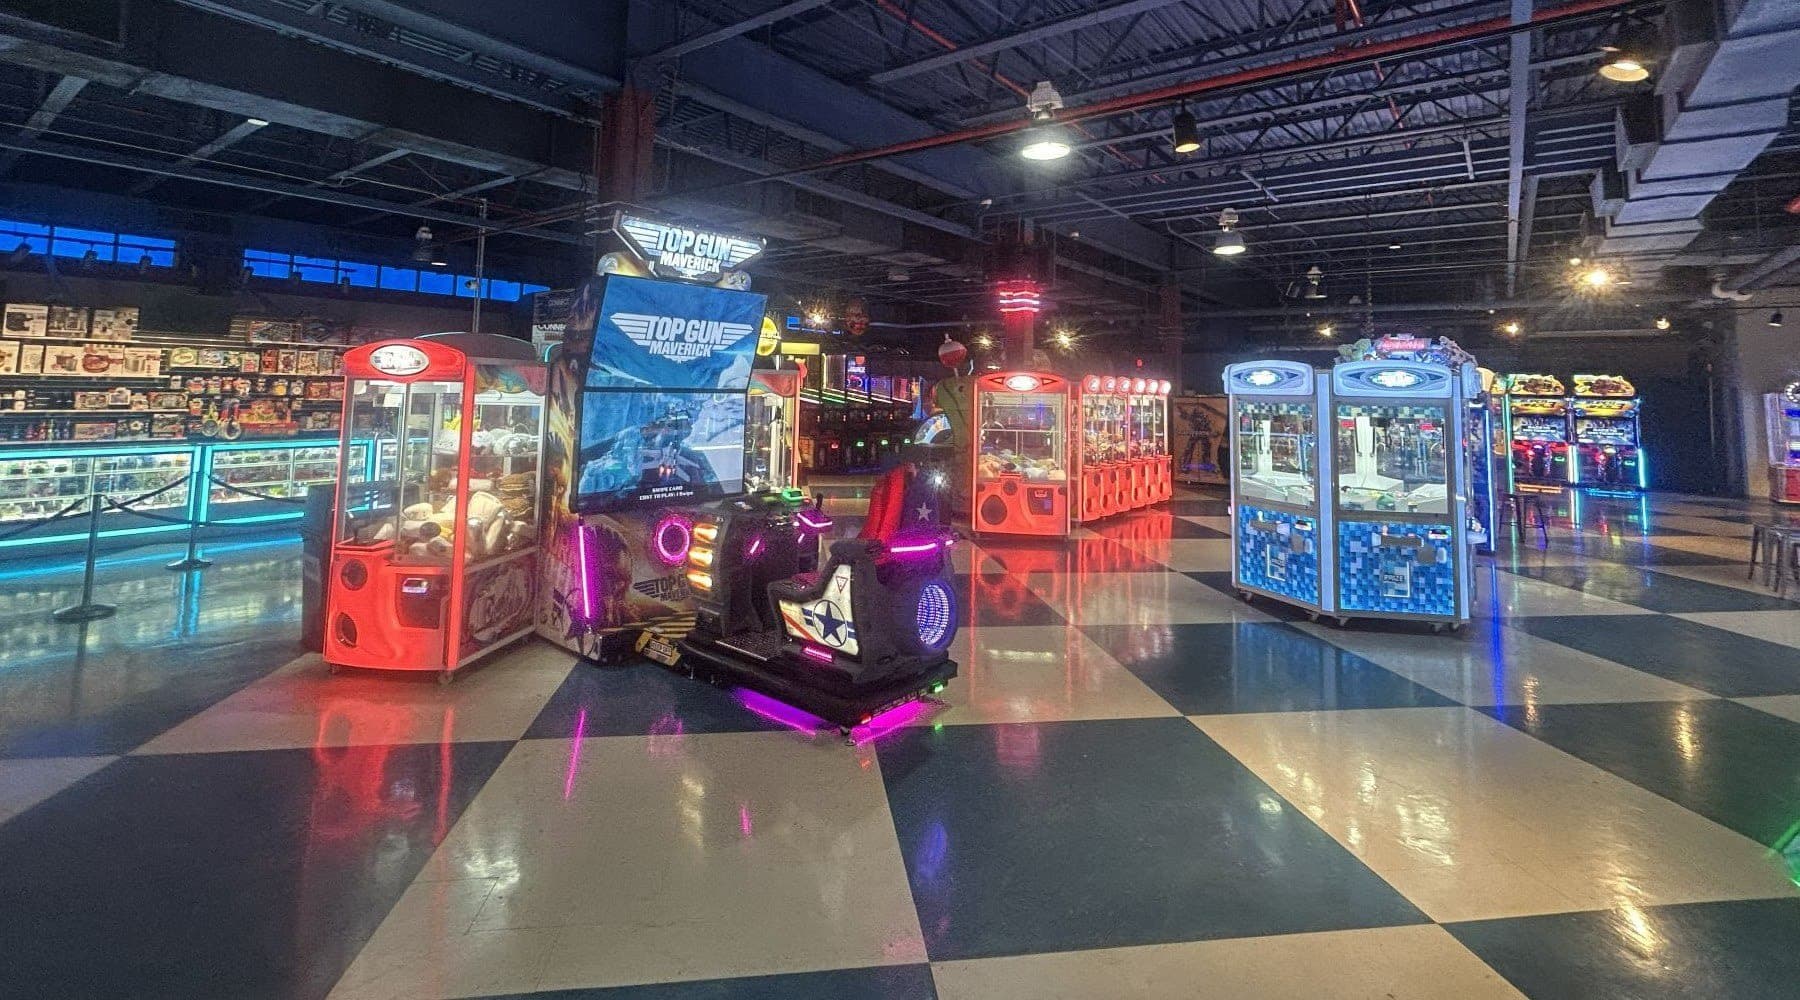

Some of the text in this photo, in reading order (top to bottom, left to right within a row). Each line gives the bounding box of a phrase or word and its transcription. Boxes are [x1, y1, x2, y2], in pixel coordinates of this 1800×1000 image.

[656, 225, 732, 260] TOP GUN
[660, 253, 721, 273] MAVERICK
[645, 316, 725, 344] TOP GUN
[649, 341, 712, 357] MAVERICK
